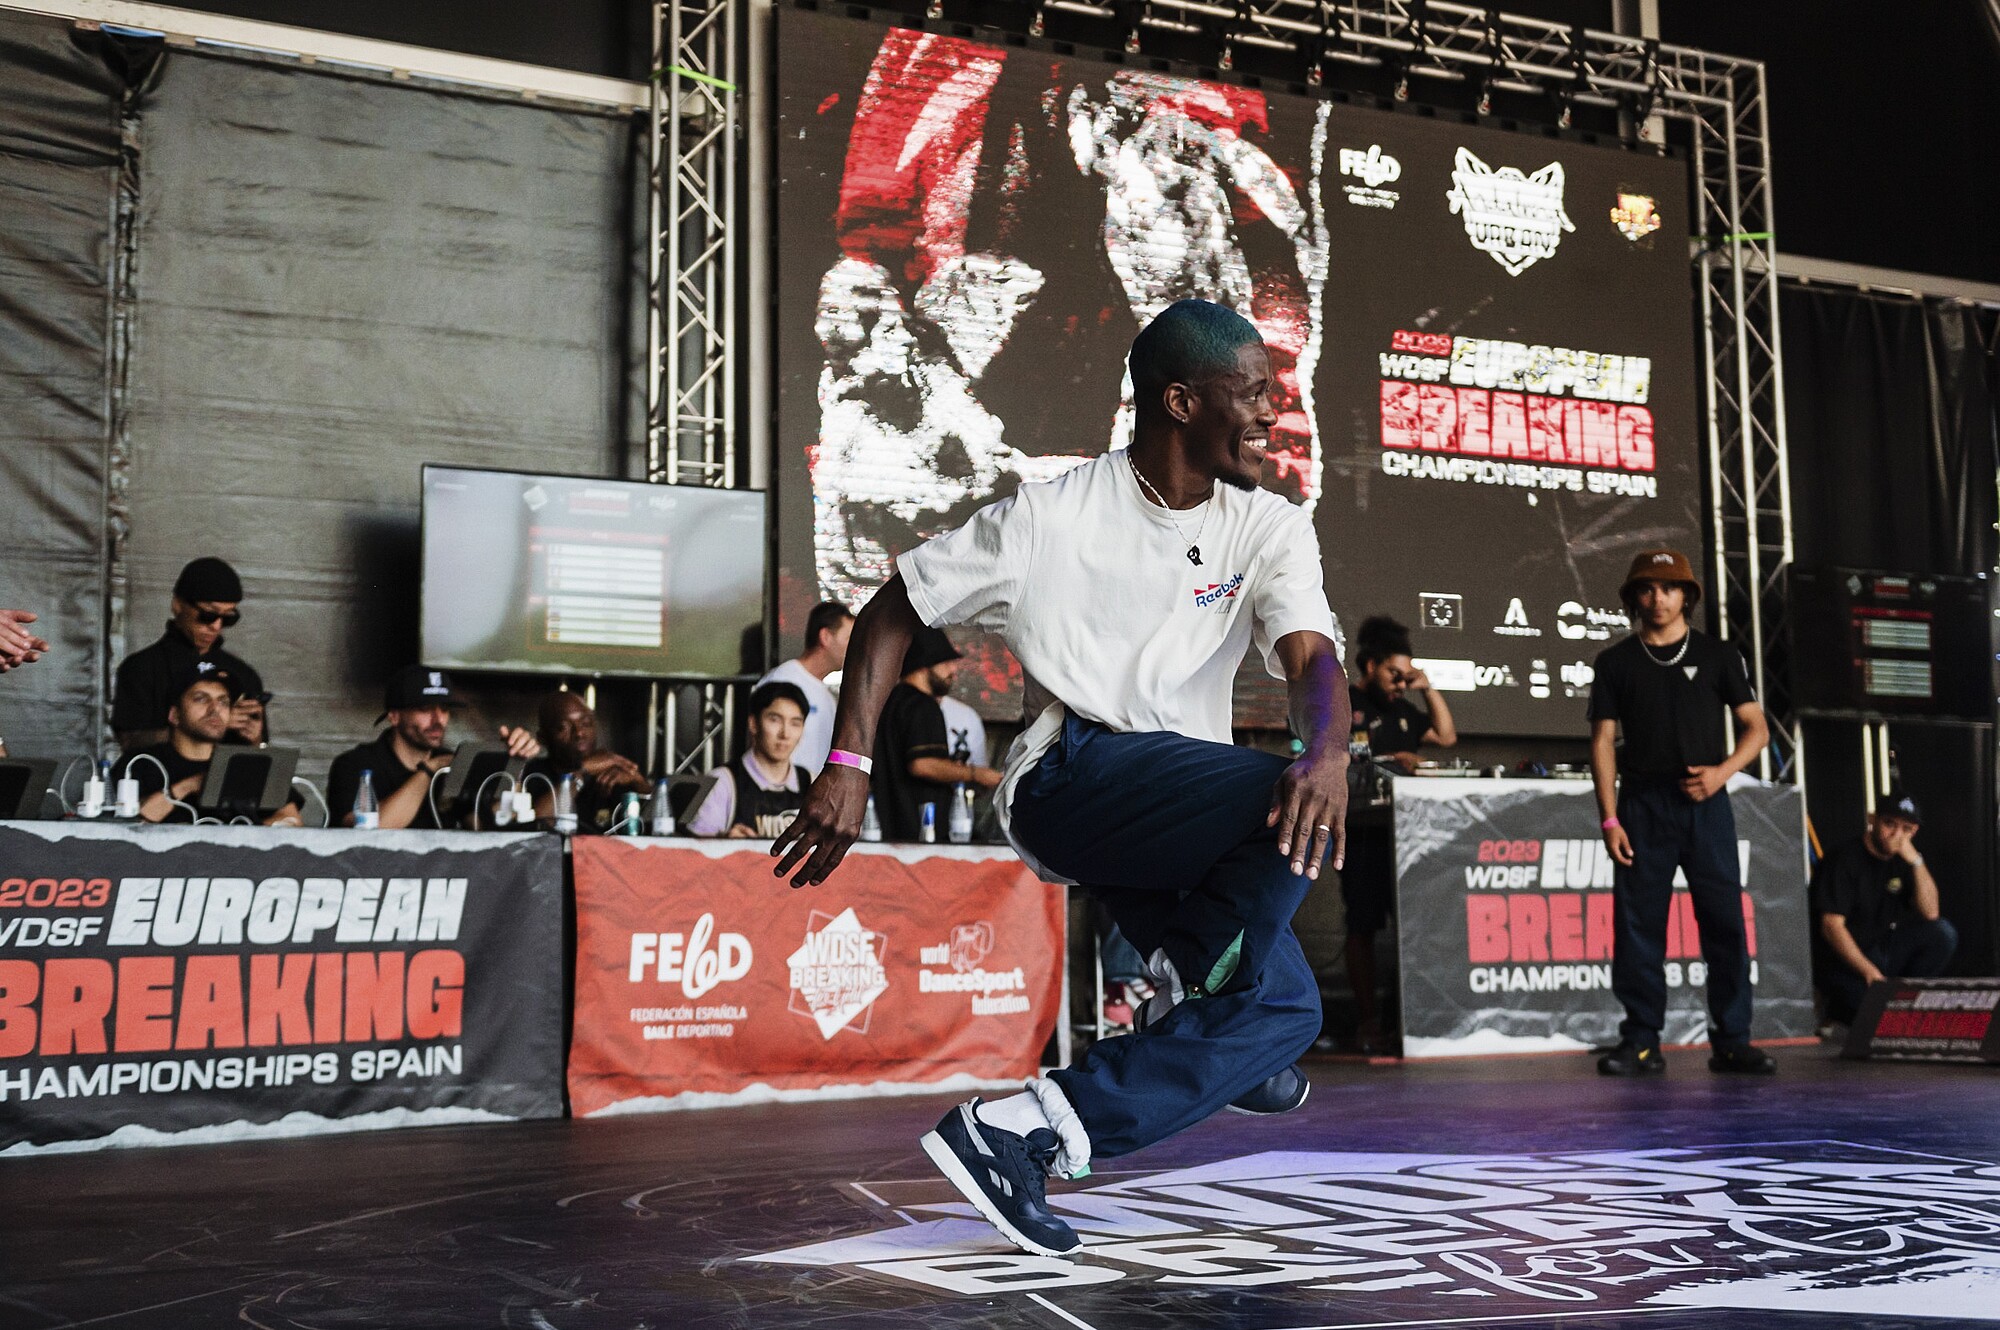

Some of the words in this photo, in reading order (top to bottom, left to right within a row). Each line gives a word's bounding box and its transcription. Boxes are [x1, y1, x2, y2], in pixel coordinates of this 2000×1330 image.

[1378, 352, 1449, 382] WDSF
[1449, 335, 1650, 404] EUROPEAN
[1379, 379, 1655, 471] BREAKING
[1381, 450, 1583, 491] CHAMPIONSHIPS
[1586, 470, 1657, 498] SPAIN
[1195, 572, 1244, 608] Reebok
[1477, 839, 1540, 863] 2023
[0, 878, 112, 908] 2023
[1465, 865, 1538, 889] WDSF
[107, 877, 468, 946] EUROPEAN
[806, 931, 876, 966] WDSF
[790, 965, 886, 989] BREAKING
[919, 967, 1026, 994] DanceSport
[0, 949, 465, 1058] BREAKING
[630, 1003, 694, 1022] FEDERACIÓN
[695, 1003, 747, 1020] ESPAÑOLA
[643, 1024, 675, 1040] BAILE
[676, 1023, 734, 1038] DEPORTIVO
[0, 1054, 338, 1101] HAMPIONSHIPS
[351, 1045, 462, 1082] SPAIN
[857, 1165, 2000, 1294] BREAKIN
[1437, 1244, 1703, 1301] for
